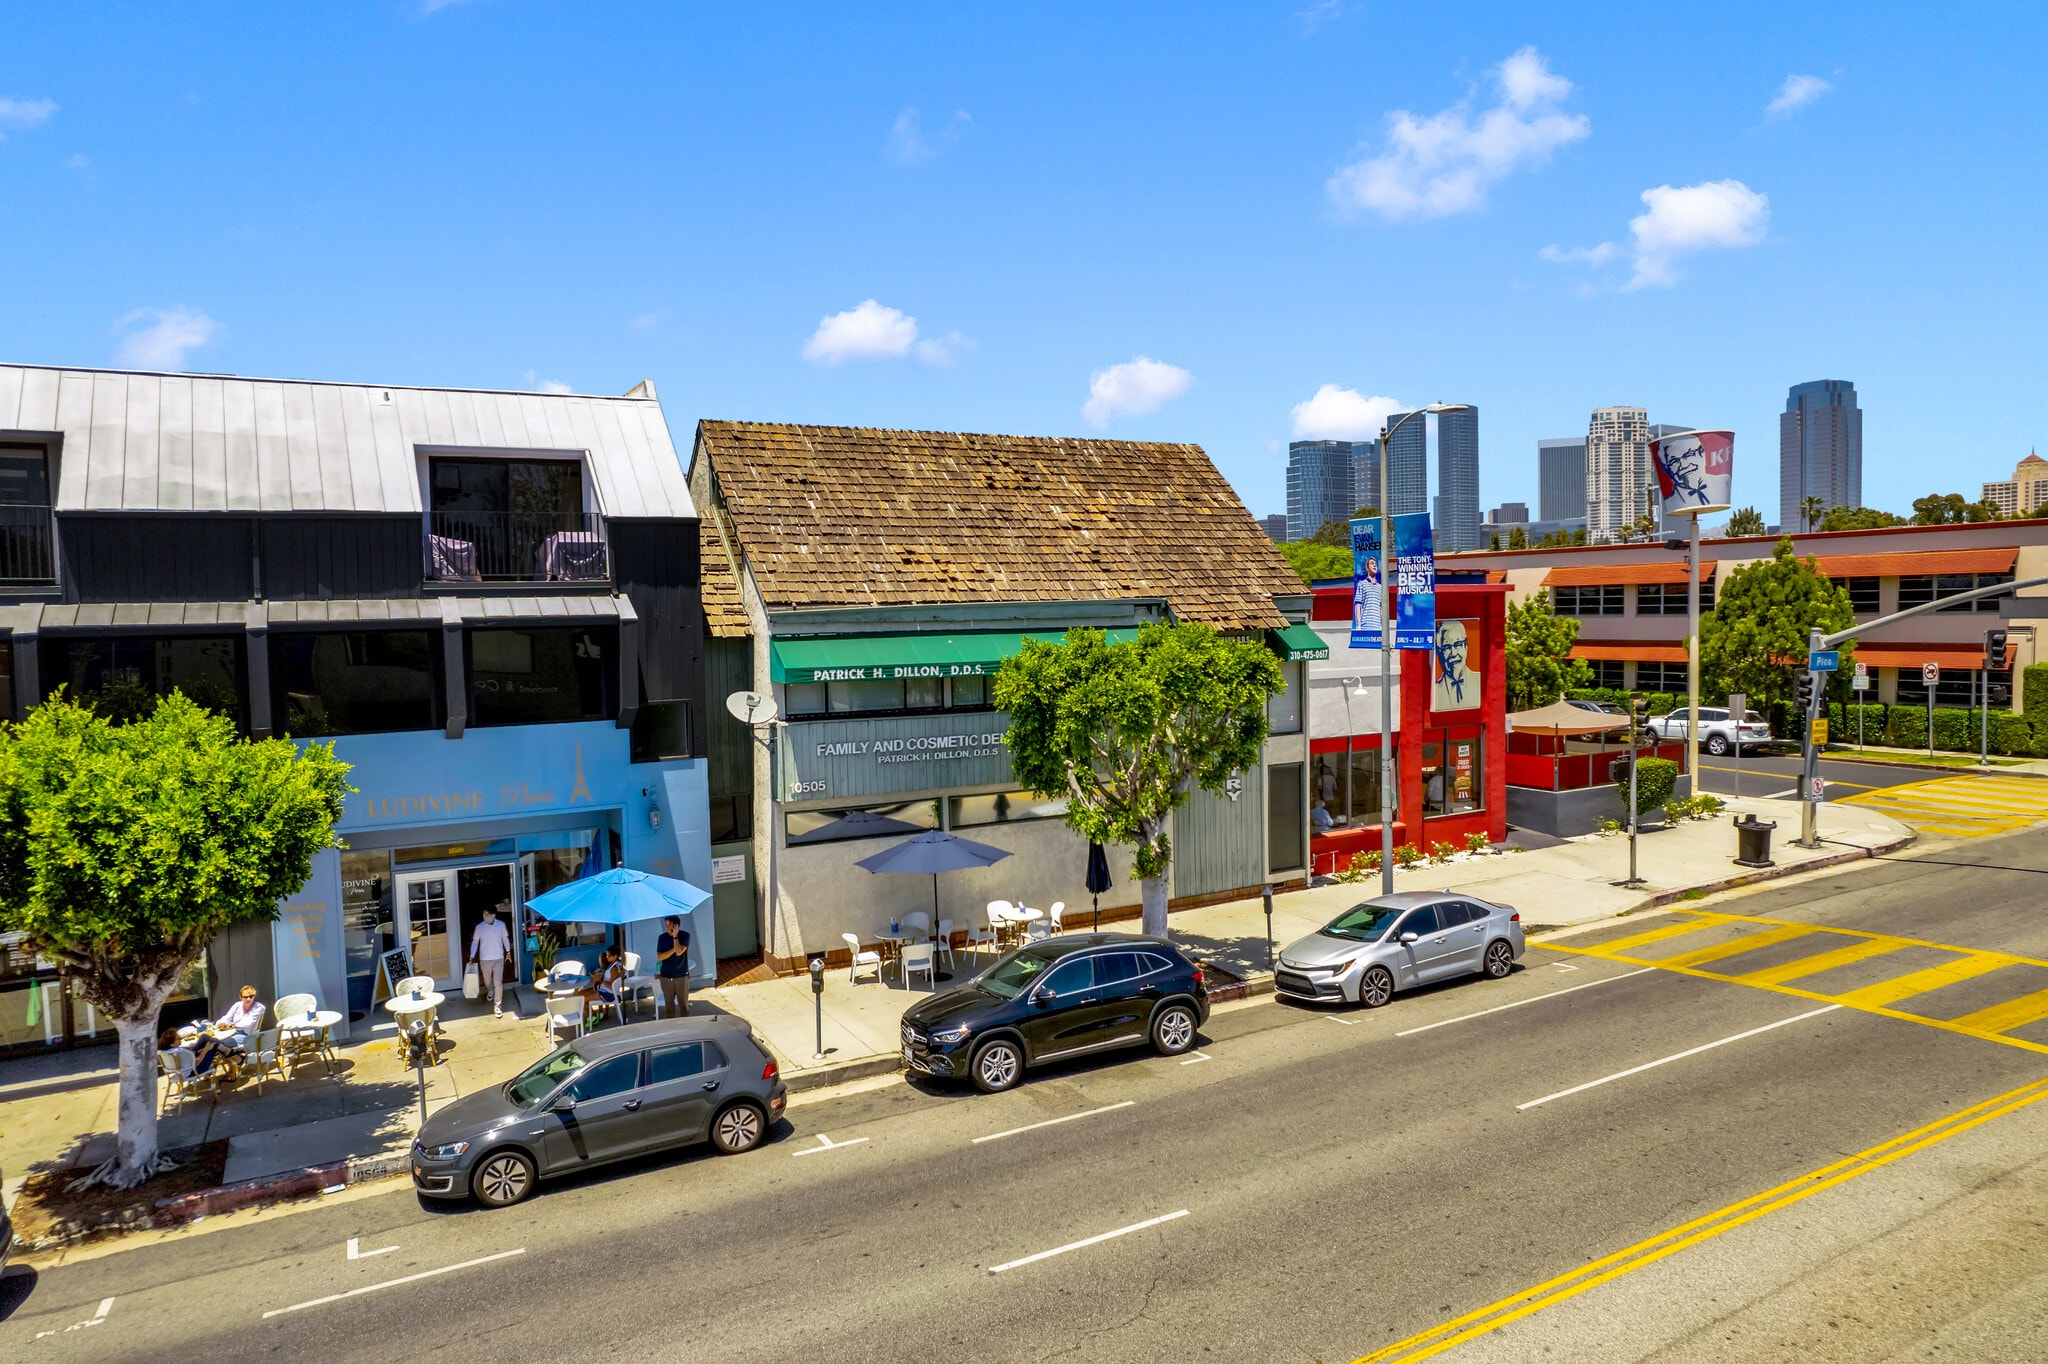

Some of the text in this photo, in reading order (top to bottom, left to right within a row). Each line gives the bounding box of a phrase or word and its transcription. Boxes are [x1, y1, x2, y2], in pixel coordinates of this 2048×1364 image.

[1353, 524, 1374, 535] DEAR
[1354, 533, 1374, 543] EVAN
[1398, 555, 1432, 565] THE TONY-
[1398, 563, 1432, 572] WINNING
[1398, 571, 1433, 586] BEST
[1398, 585, 1434, 595] MUSICAL
[1290, 649, 1328, 660] 310-475-0617
[1816, 656, 1832, 667] Pico
[814, 664, 985, 681] PATRICK H. DILLON, D.D.S.
[817, 741, 870, 757] FAMILY
[872, 738, 904, 753] AND
[906, 734, 979, 750] COSMETIC
[878, 747, 999, 764] PATRICK H. DILLON, D.D.S
[789, 780, 826, 794] 10505
[369, 791, 485, 817] LUDIVINE
